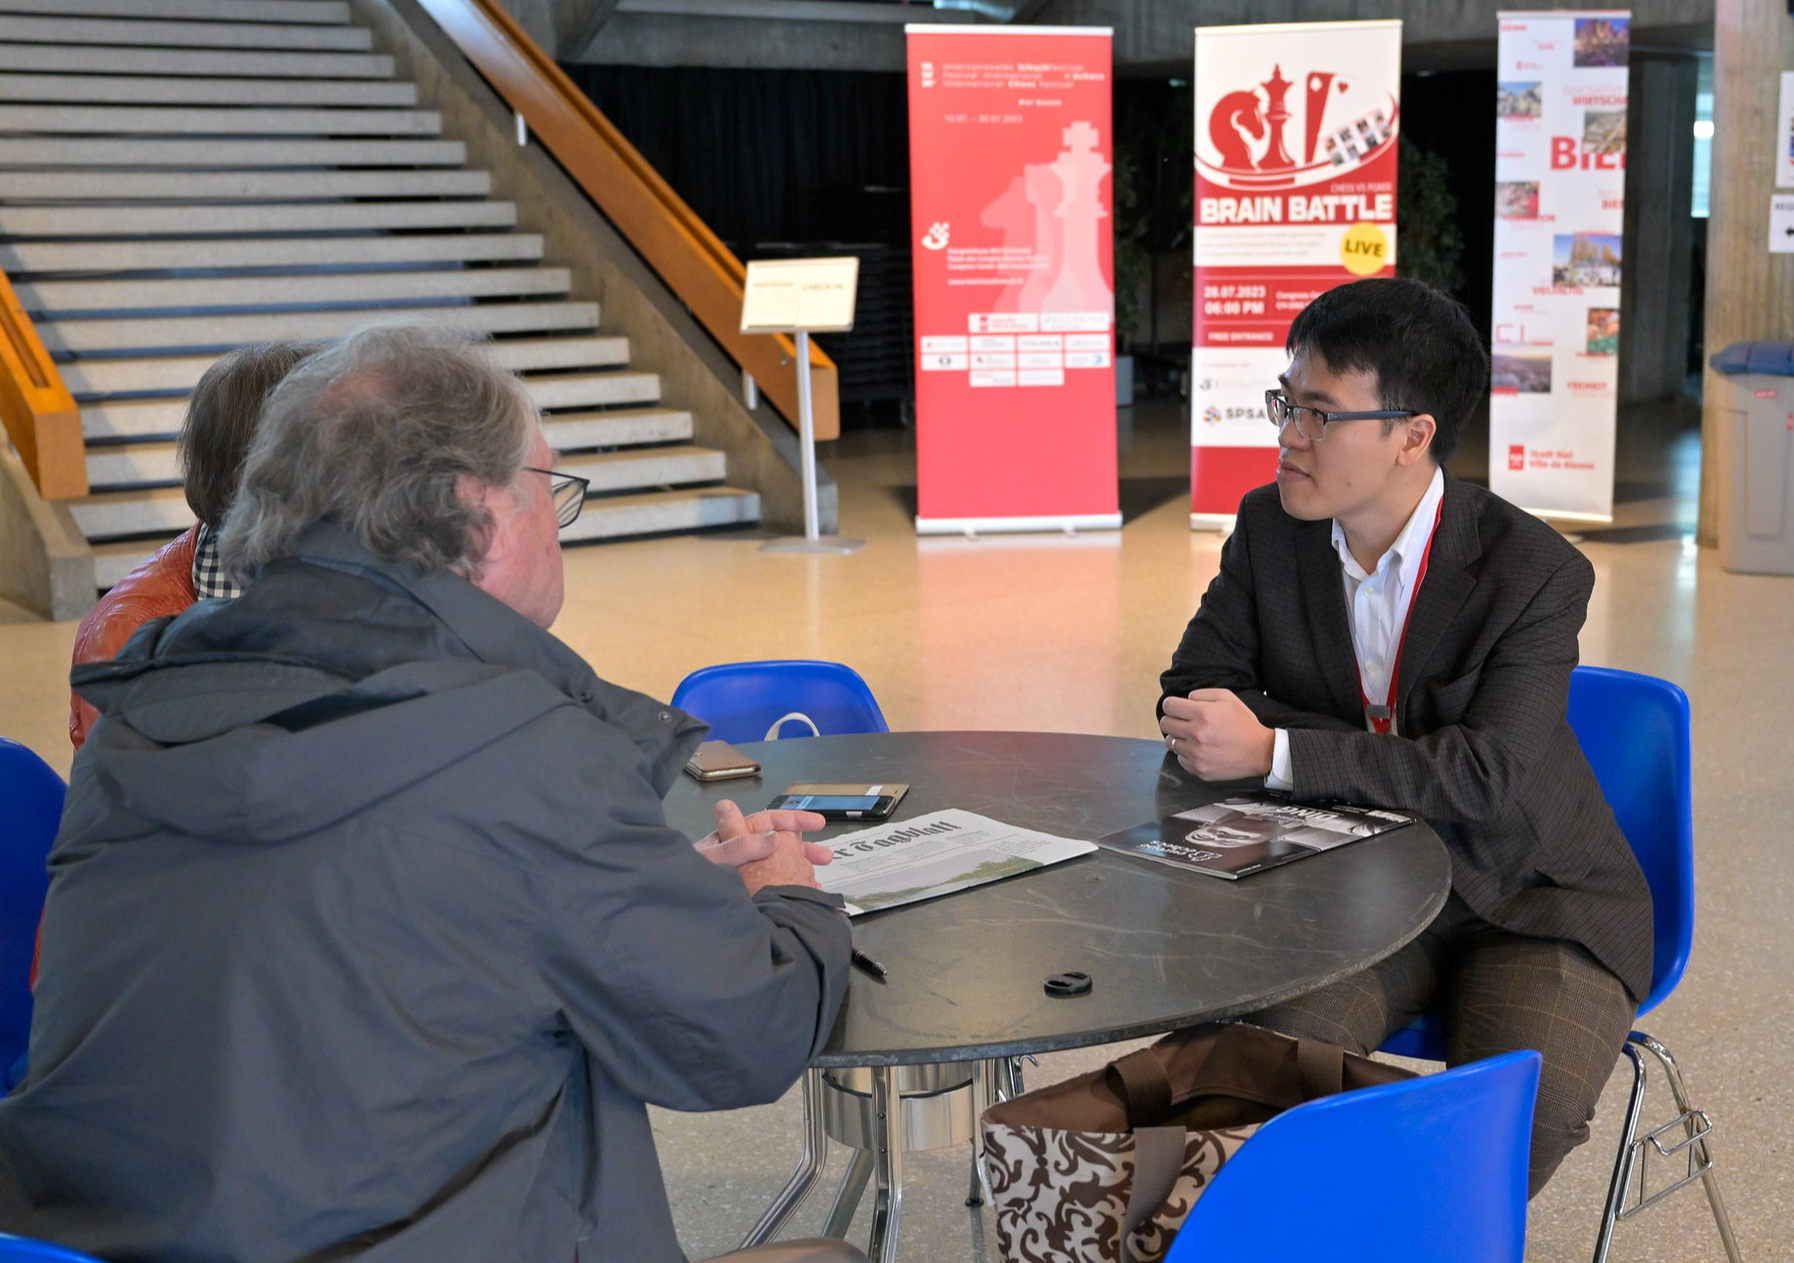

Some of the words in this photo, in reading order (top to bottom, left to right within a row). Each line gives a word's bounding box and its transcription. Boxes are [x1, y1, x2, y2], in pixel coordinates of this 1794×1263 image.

[1200, 196, 1283, 223] BRAIN
[1288, 194, 1393, 221] BATTLE
[1345, 239, 1383, 257] LIVE
[1242, 301, 1264, 315] PM
[1208, 331, 1229, 341] FREE
[1230, 331, 1274, 341] ENTRANCE
[1225, 407, 1267, 420] SPSA
[849, 820, 962, 852] Tagblatt
